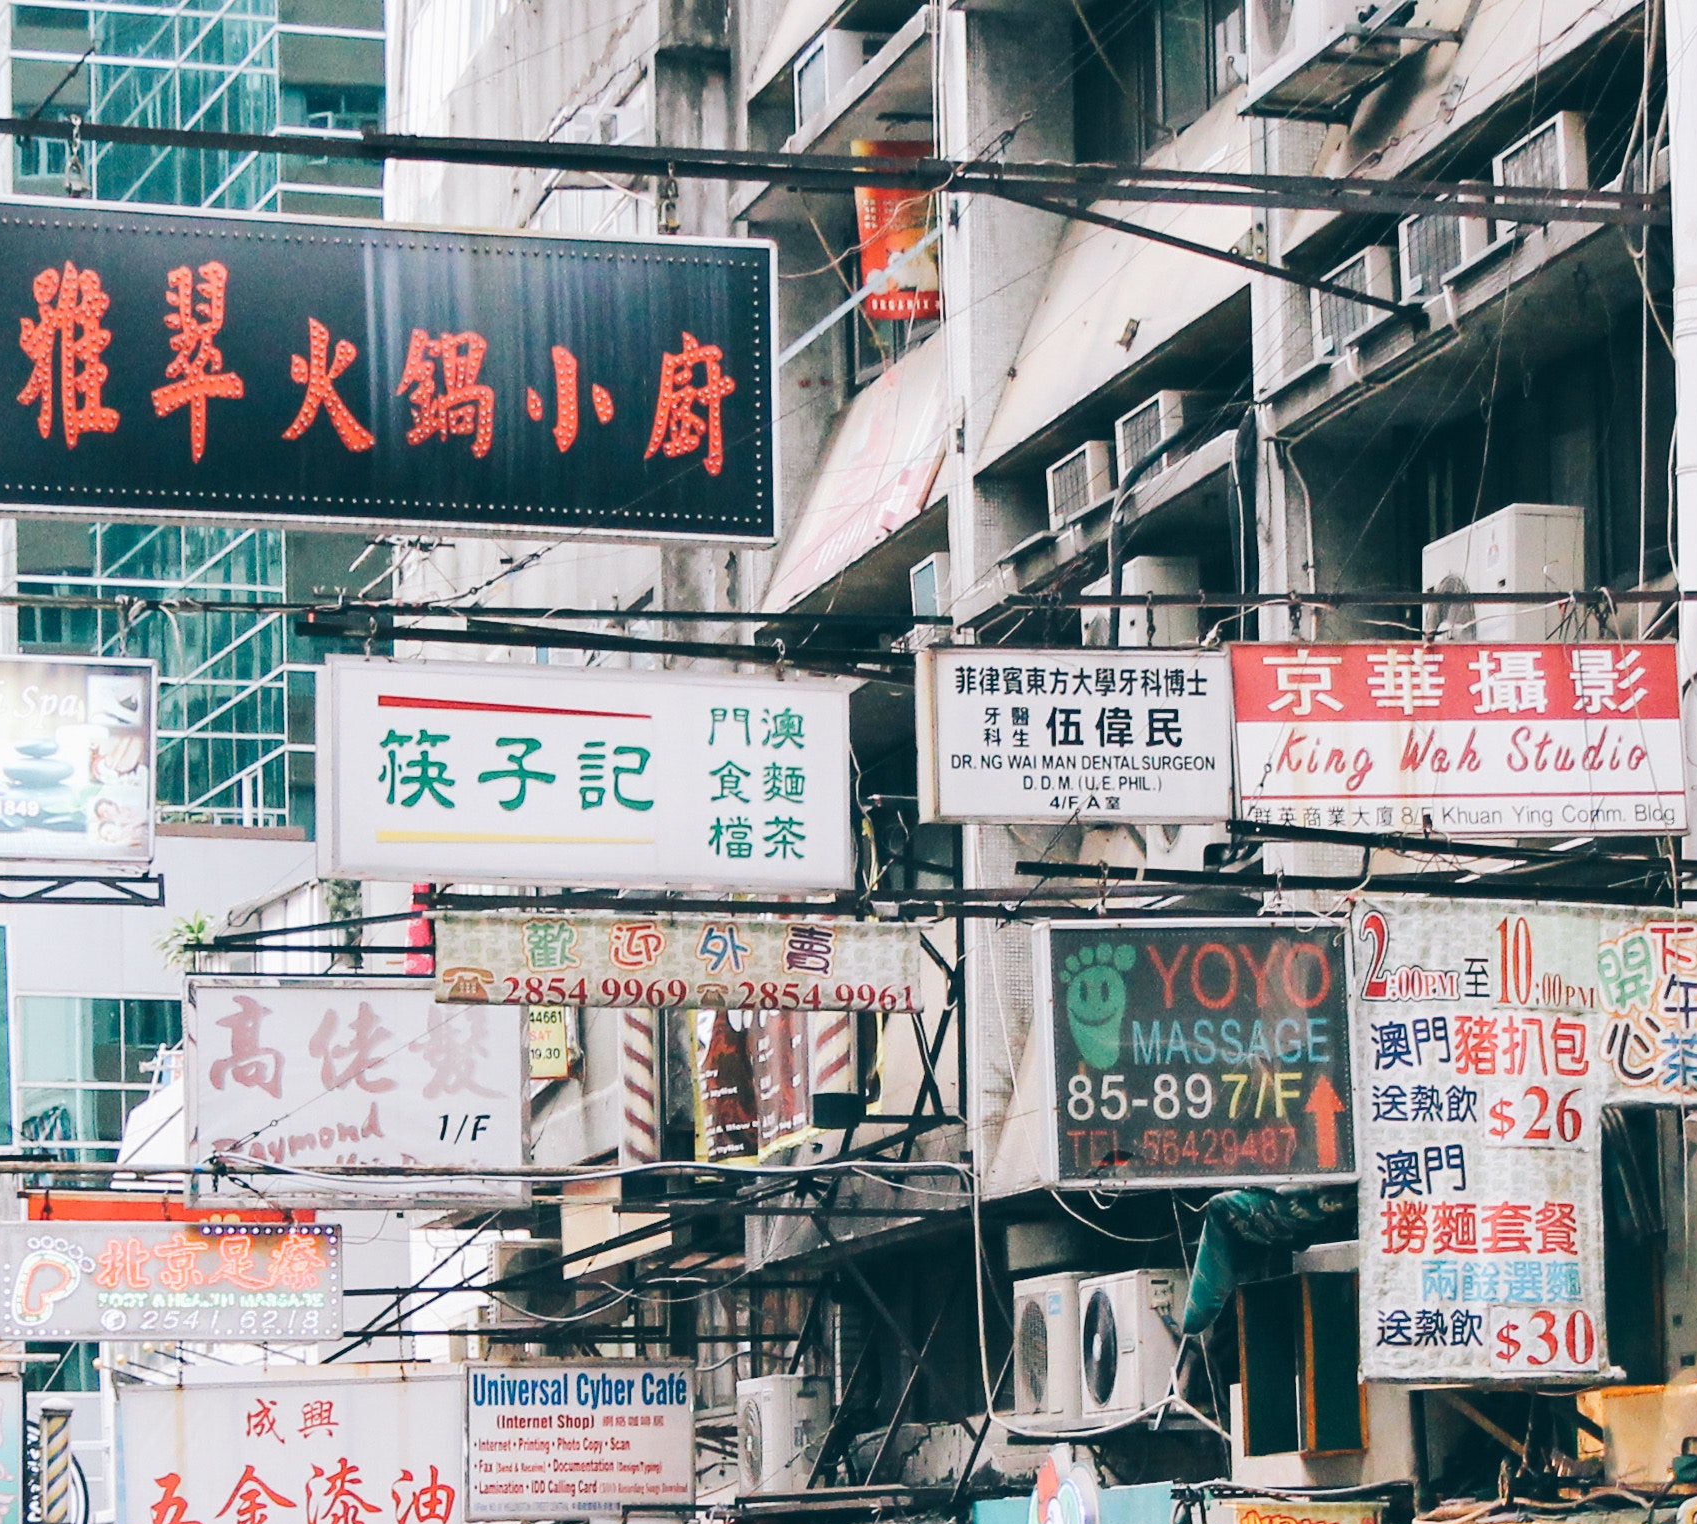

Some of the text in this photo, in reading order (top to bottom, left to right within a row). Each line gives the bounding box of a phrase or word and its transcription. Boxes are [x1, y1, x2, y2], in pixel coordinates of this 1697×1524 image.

[1261, 647, 1647, 718] 京華攝影
[14, 684, 81, 730] Spa
[1045, 706, 1183, 748] 伍偉民
[378, 727, 655, 812] 筷子記
[951, 754, 1216, 771] DR. NG WAI MAN DENTAL SURGEON
[1276, 727, 1374, 792] King
[1506, 725, 1649, 772] Studio
[1441, 804, 1503, 825] Khuan
[1511, 805, 1554, 828] Ying
[522, 918, 837, 979] 歡迎外賣
[503, 976, 688, 1008] 2854 9969
[736, 980, 917, 1012] 2854 9961
[1146, 942, 1332, 1010] YOYO
[1463, 957, 1491, 1000] 至
[1132, 1017, 1331, 1066] MASSAGE
[1066, 1071, 1303, 1121] 85-89 7/F
[1487, 1084, 1583, 1143] $26
[1376, 1143, 1467, 1200] 澳門
[1495, 1309, 1596, 1366] $30
[472, 1371, 688, 1410] Universal Cyber Café
[496, 1414, 553, 1429] (Internet
[557, 1414, 595, 1430] Shop)
[557, 1437, 581, 1451] Photo
[582, 1437, 603, 1454] Copy
[609, 1437, 631, 1451] Scan
[578, 1480, 598, 1494] Card
